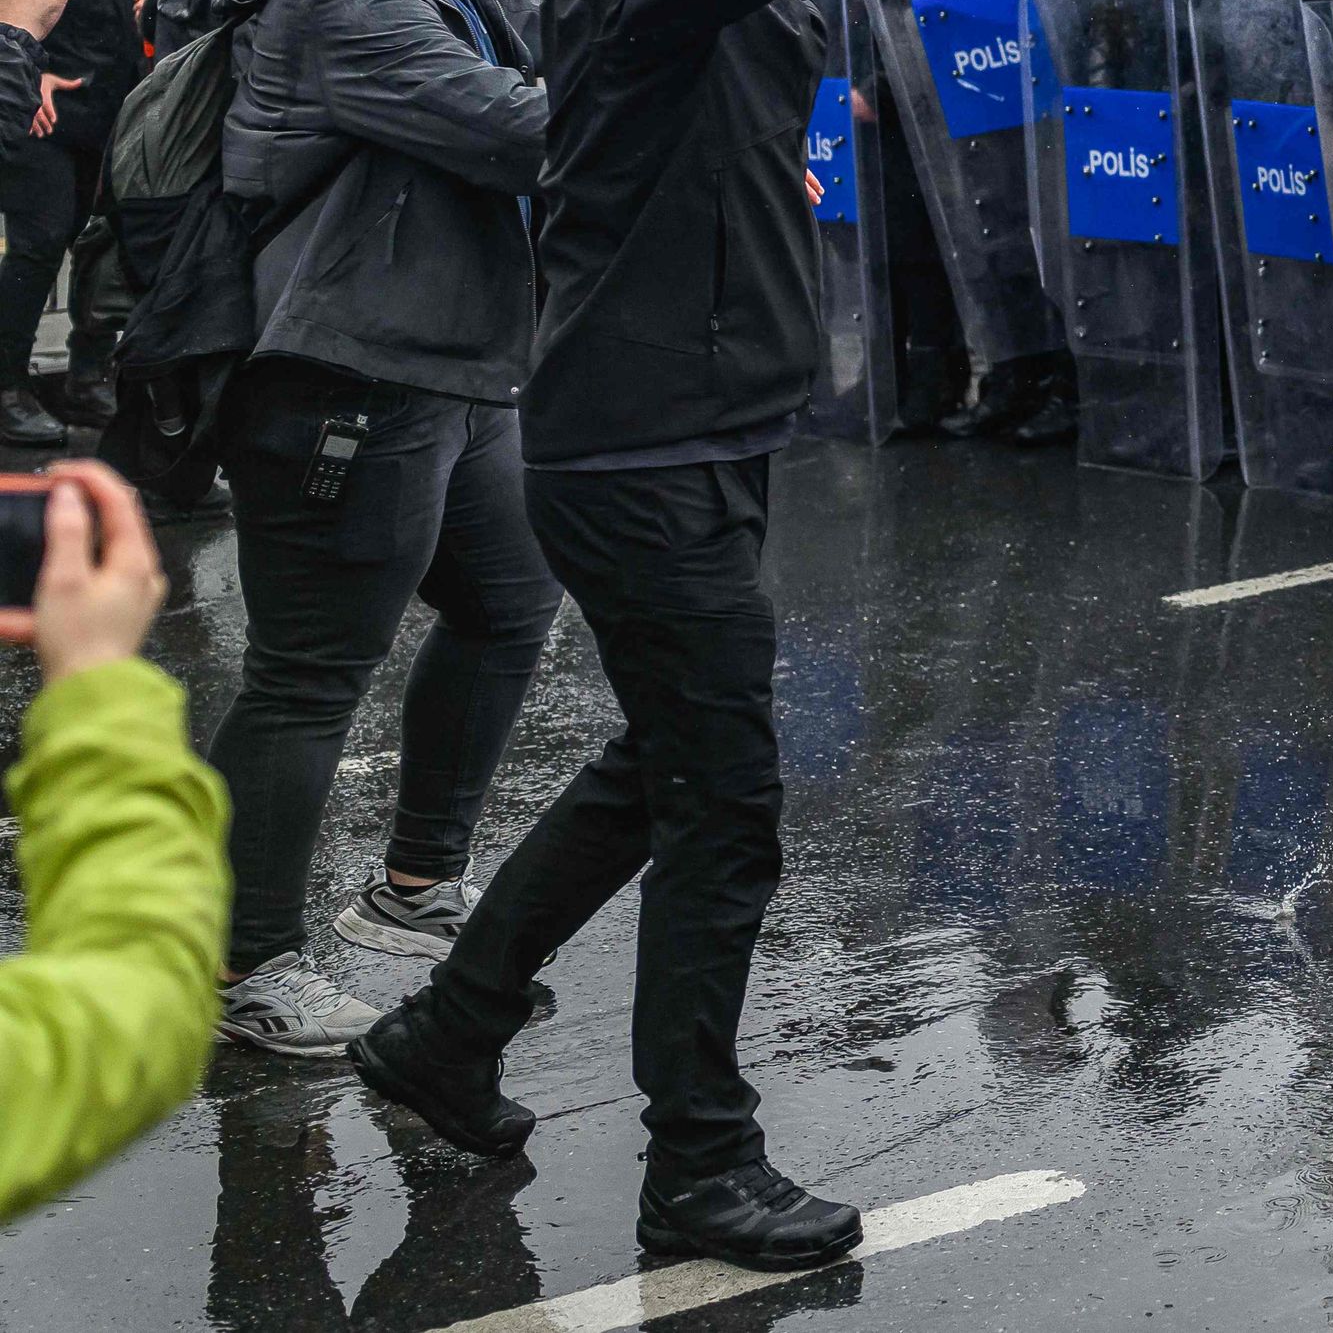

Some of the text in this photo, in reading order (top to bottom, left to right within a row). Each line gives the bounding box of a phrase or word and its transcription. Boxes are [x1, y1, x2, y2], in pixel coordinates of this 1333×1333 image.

[954, 37, 1021, 76] POLİS
[1089, 147, 1150, 179] POLİS
[1257, 164, 1307, 196] POLİS
